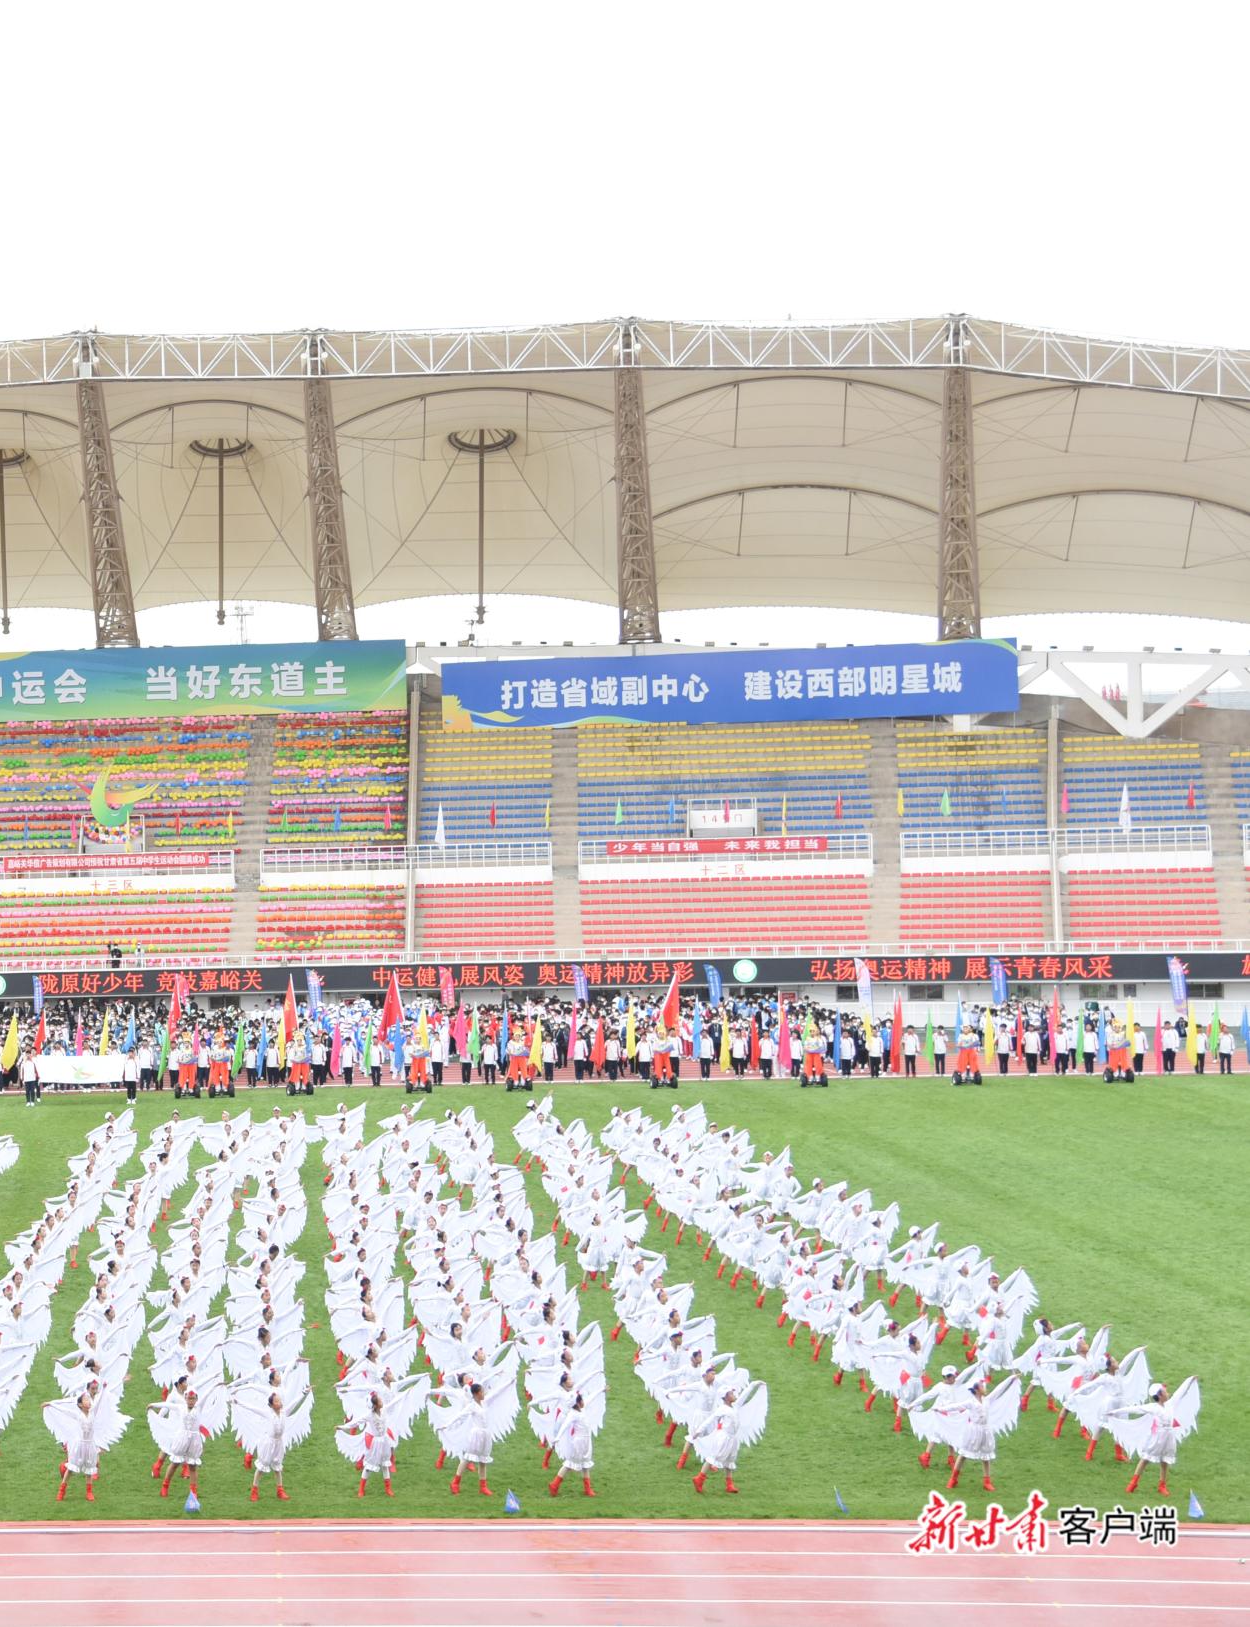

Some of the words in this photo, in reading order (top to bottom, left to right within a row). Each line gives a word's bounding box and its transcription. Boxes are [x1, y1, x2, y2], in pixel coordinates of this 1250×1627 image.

[145, 660, 348, 702] 当好东道主
[500, 672, 710, 711] 打造省域副中心
[743, 661, 963, 701] 建设西部明星城
[702, 814, 742, 824] 14门
[613, 841, 700, 853] 少年当自强
[723, 838, 820, 851] 未来我担当
[701, 864, 747, 876] 十二区
[91, 879, 135, 890] 十三区
[37, 971, 144, 995] 陇原好少年
[537, 961, 695, 986] 奥运精神放异彩
